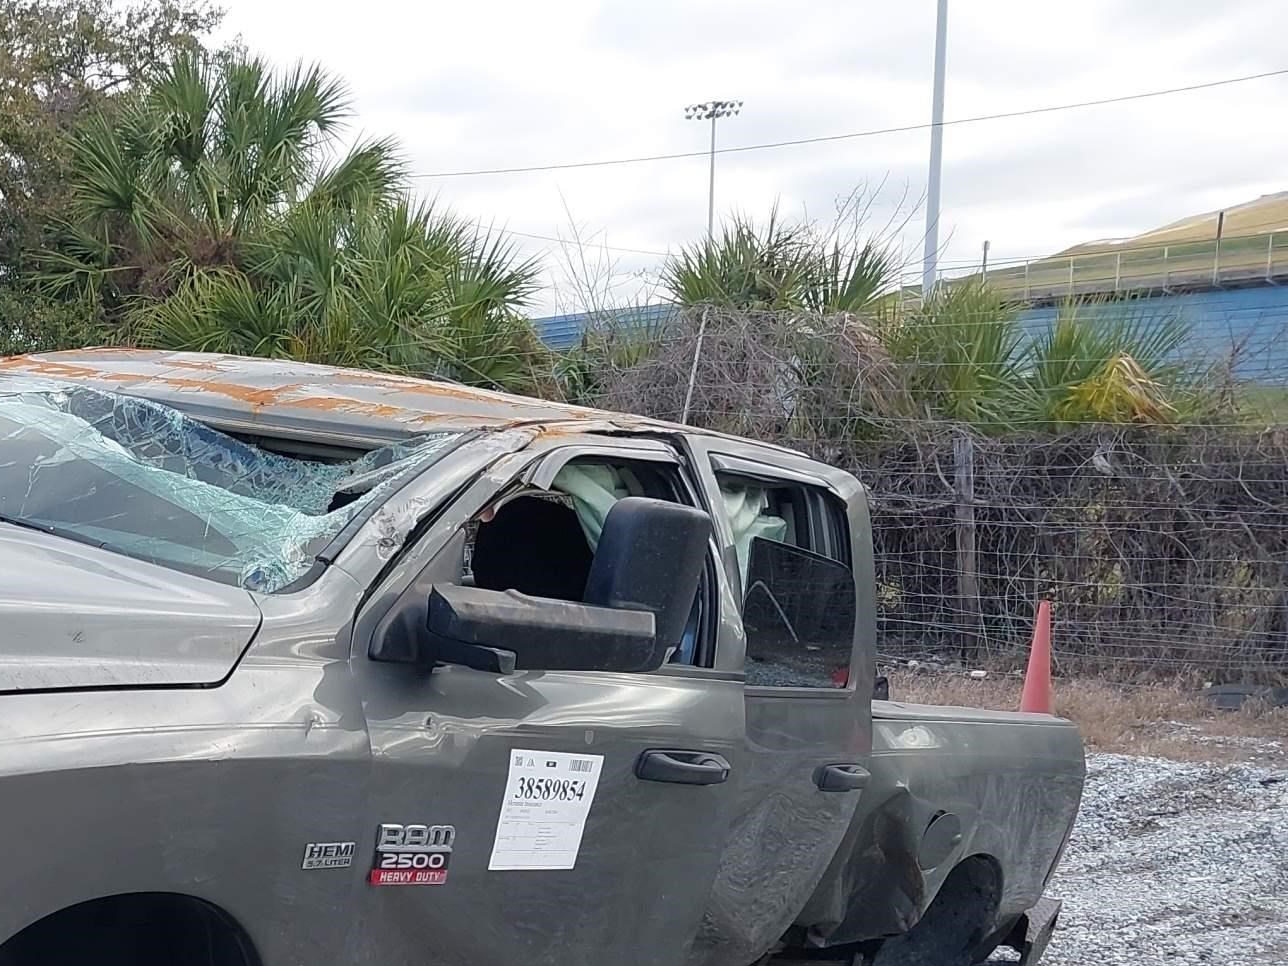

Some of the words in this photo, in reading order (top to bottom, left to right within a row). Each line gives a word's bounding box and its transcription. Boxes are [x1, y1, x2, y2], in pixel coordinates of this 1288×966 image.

[514, 776, 587, 801] 38589854
[376, 823, 456, 851] RAM
[309, 843, 355, 858] HEMI
[324, 857, 351, 866] LITER
[380, 853, 445, 869] 2500
[379, 871, 413, 882] HEAVY
[415, 871, 441, 882] DUTY
